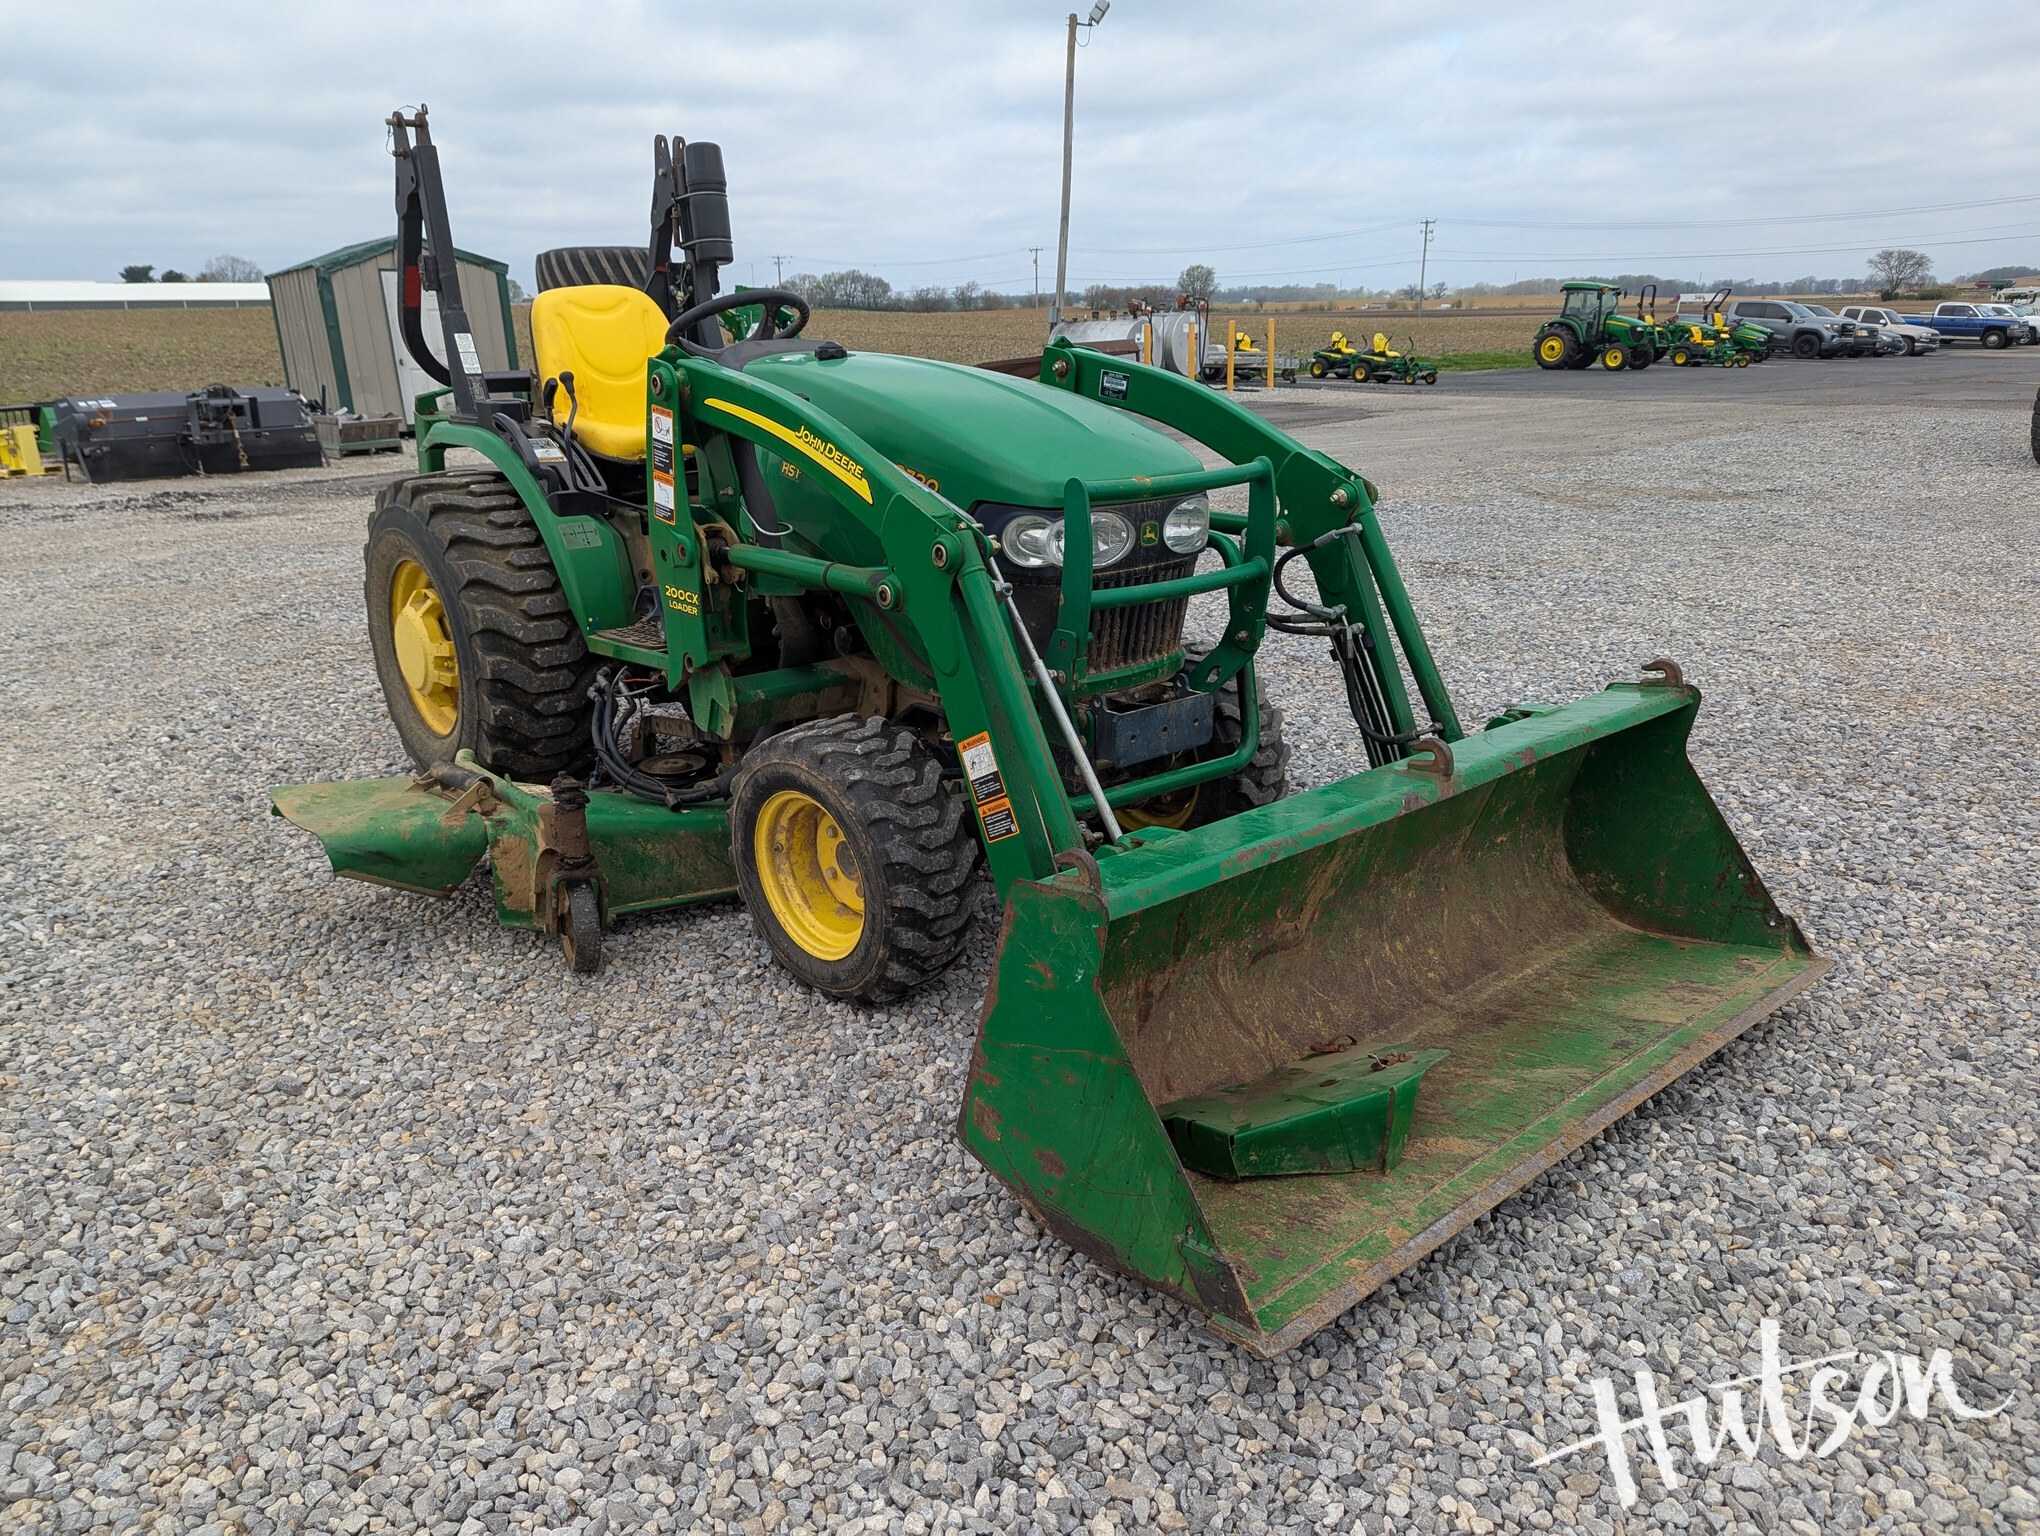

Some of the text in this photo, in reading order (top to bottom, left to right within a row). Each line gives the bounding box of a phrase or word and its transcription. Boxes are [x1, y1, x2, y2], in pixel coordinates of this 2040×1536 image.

[795, 425, 864, 480] JOHN DEERE
[665, 585, 699, 605] 200CX
[669, 600, 698, 616] LOADER
[987, 801, 1007, 813] WARNING
